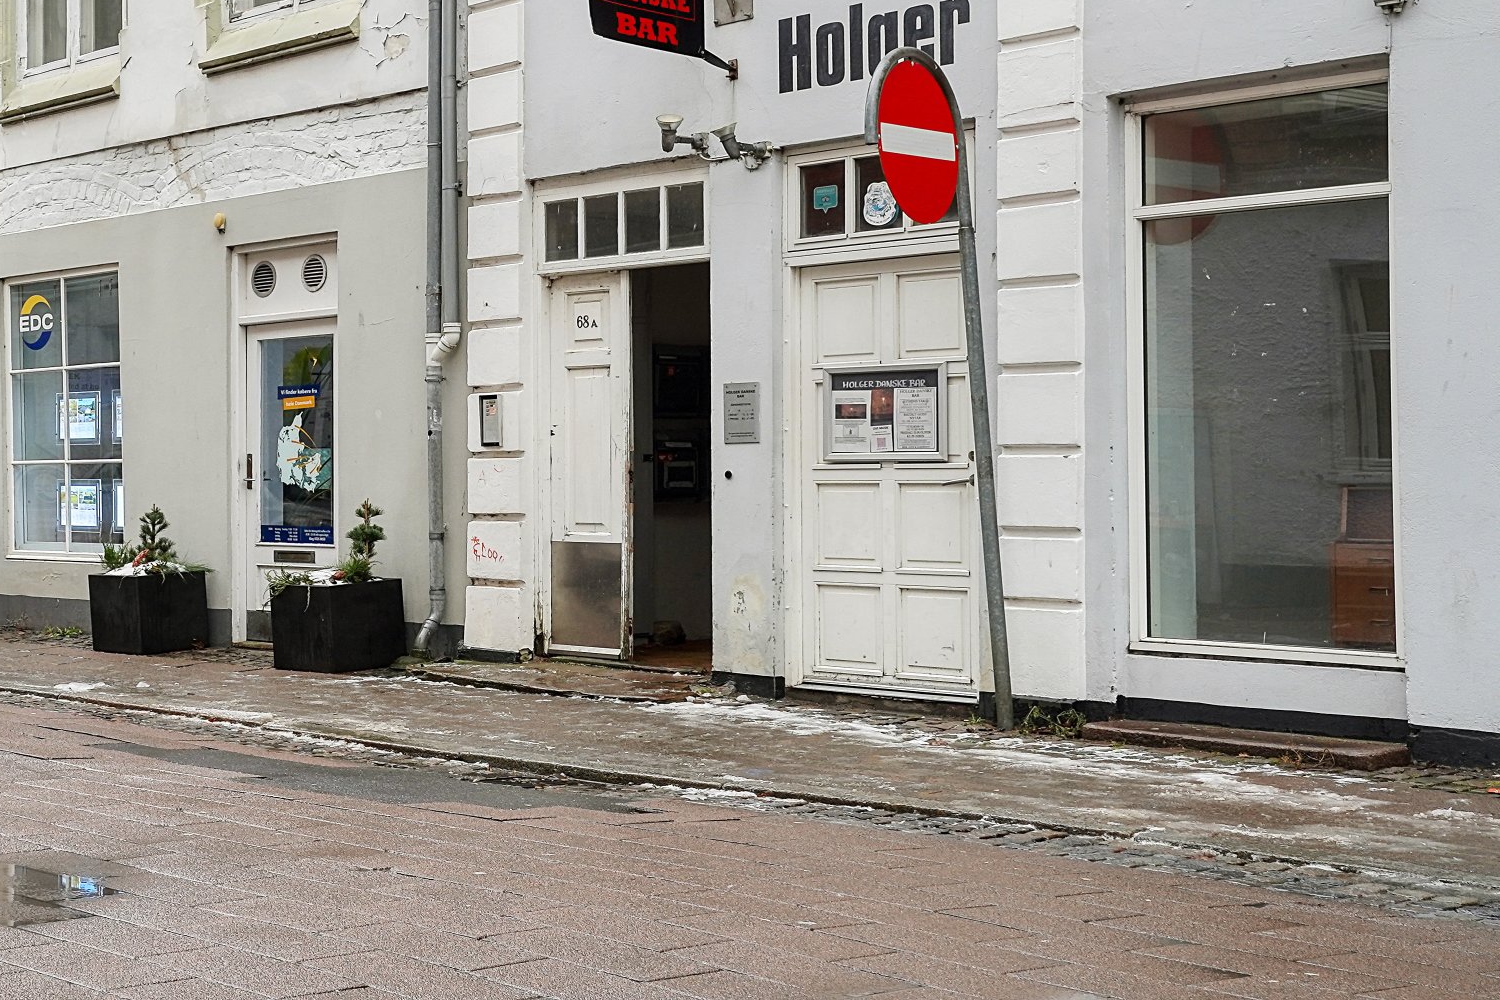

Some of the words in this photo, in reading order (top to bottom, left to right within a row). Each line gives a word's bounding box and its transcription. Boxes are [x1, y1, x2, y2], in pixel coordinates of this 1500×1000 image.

[616, 11, 678, 46] BAR
[19, 313, 54, 333] EDC
[576, 315, 590, 328] 68
[842, 380, 874, 389] HOLGER
[875, 379, 908, 388] DANSKE
[909, 379, 926, 387] BAR
